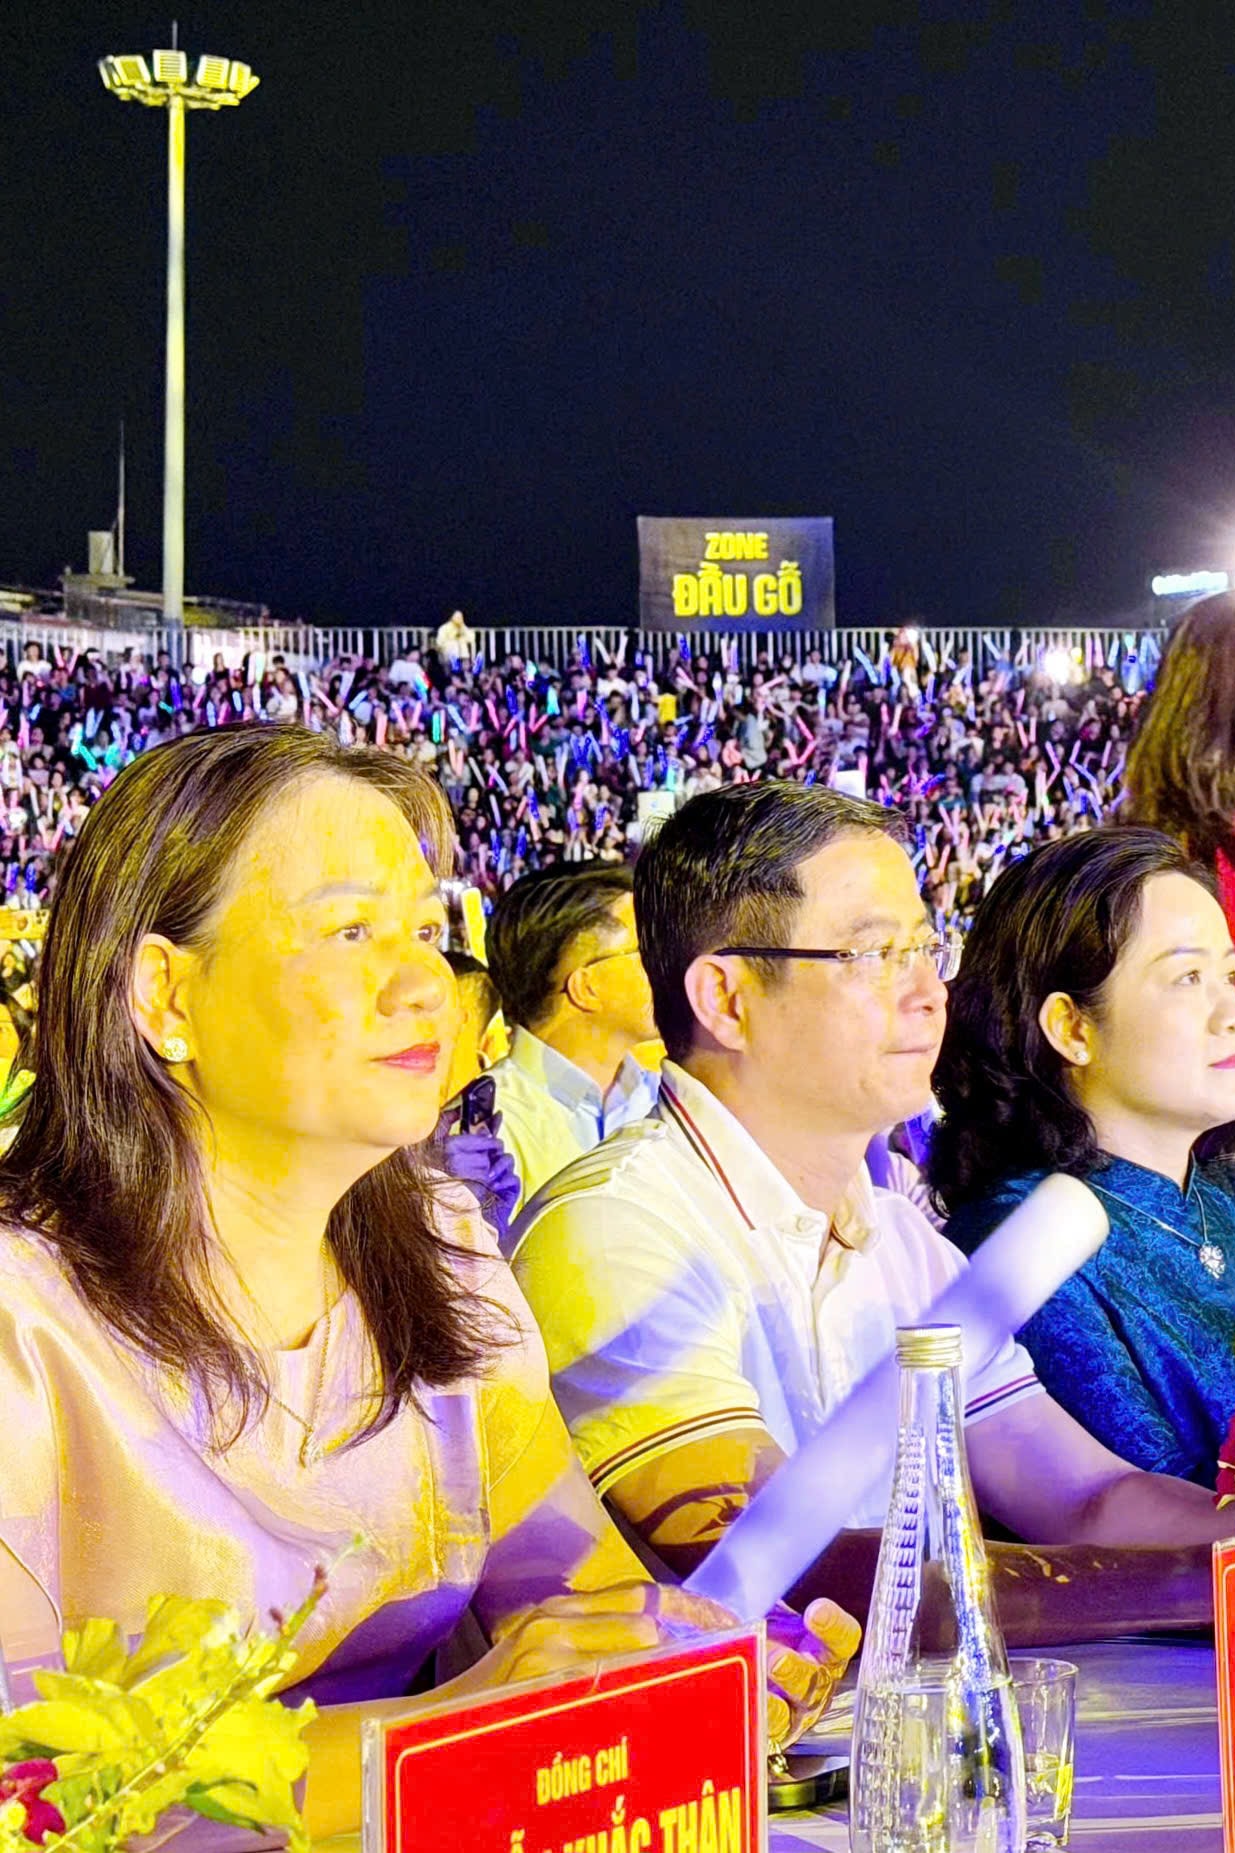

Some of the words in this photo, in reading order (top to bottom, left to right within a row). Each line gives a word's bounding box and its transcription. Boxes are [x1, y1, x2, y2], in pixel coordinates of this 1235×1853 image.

[704, 532, 769, 560] ZONE
[672, 561, 747, 617] ĐẦU
[753, 560, 803, 616] GỖ
[536, 1752, 592, 1806] ĐỒNG
[596, 1737, 629, 1786] CHÍ
[563, 1796, 652, 1853] ẮC
